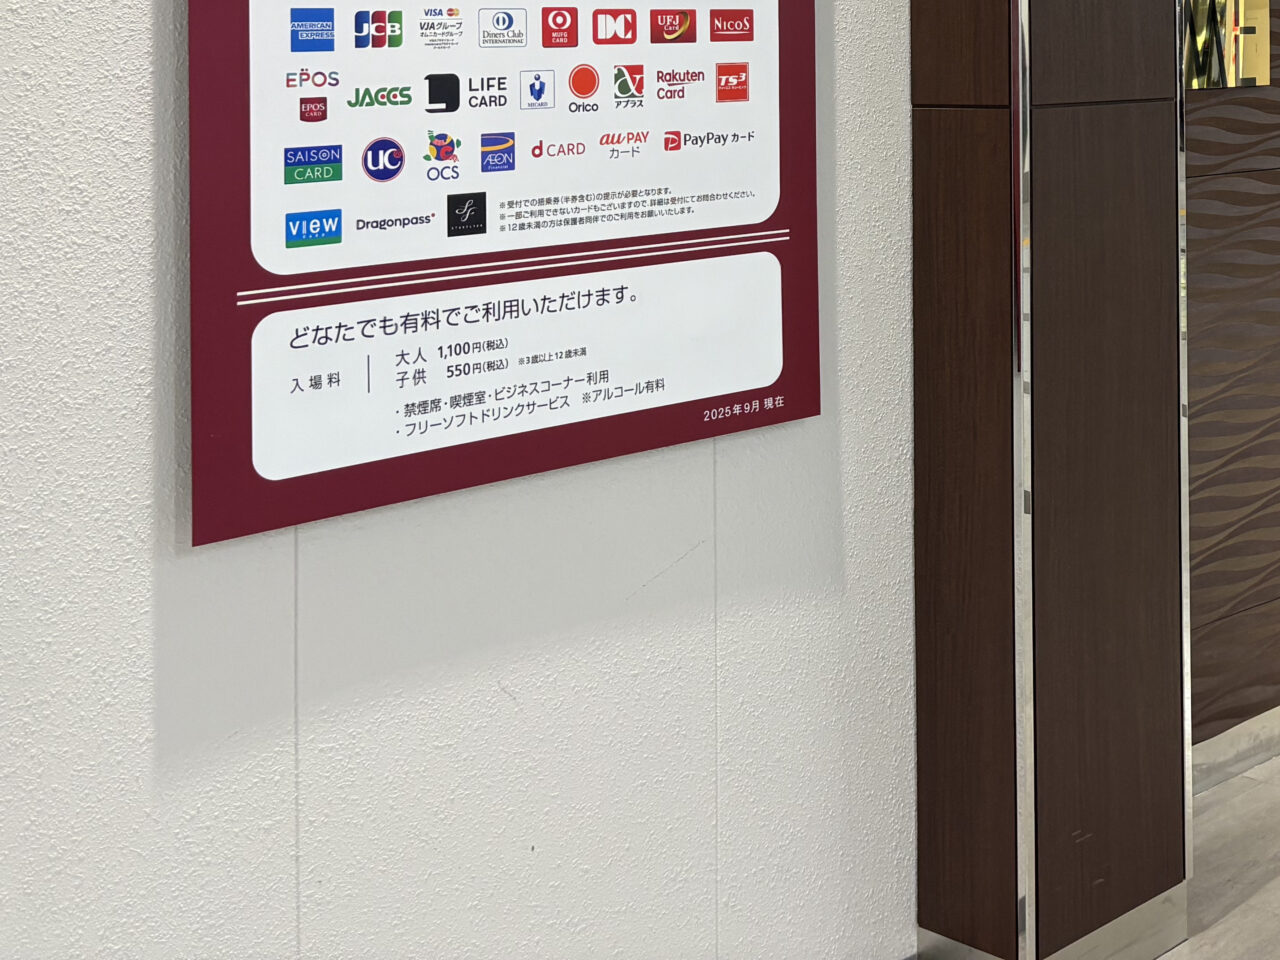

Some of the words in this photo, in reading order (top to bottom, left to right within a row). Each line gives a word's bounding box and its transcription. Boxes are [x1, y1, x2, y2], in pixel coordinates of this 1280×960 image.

[424, 8, 443, 17] VISA
[291, 22, 332, 30] AMERICAN
[419, 21, 463, 31] VJAグループ
[657, 15, 679, 26] UFJ
[299, 31, 335, 39] EXPRESS
[354, 22, 402, 36] JCB
[482, 30, 505, 39] Diners
[506, 29, 524, 39] Club
[286, 69, 340, 88] EPOS
[657, 70, 705, 83] Rakuten
[468, 77, 508, 92] LIFE
[346, 86, 413, 108] JACCS
[657, 86, 685, 100] Card
[301, 102, 326, 112] EPOS
[468, 95, 508, 108] CARD
[569, 102, 599, 113] Orico
[615, 99, 644, 109] アプラス
[683, 132, 729, 147] PayPay
[731, 131, 755, 143] カード
[287, 149, 340, 163] SAISON
[609, 146, 641, 159] カード
[294, 166, 333, 181] CARD
[427, 166, 459, 181] OCS
[356, 215, 431, 231] Dragonpass
[289, 284, 639, 349] どなたでも有料でご利用いただけます。
[395, 347, 427, 366] 大人
[395, 367, 427, 388] 子供
[703, 400, 760, 422] 2025年9月
[764, 396, 785, 410] 現在
